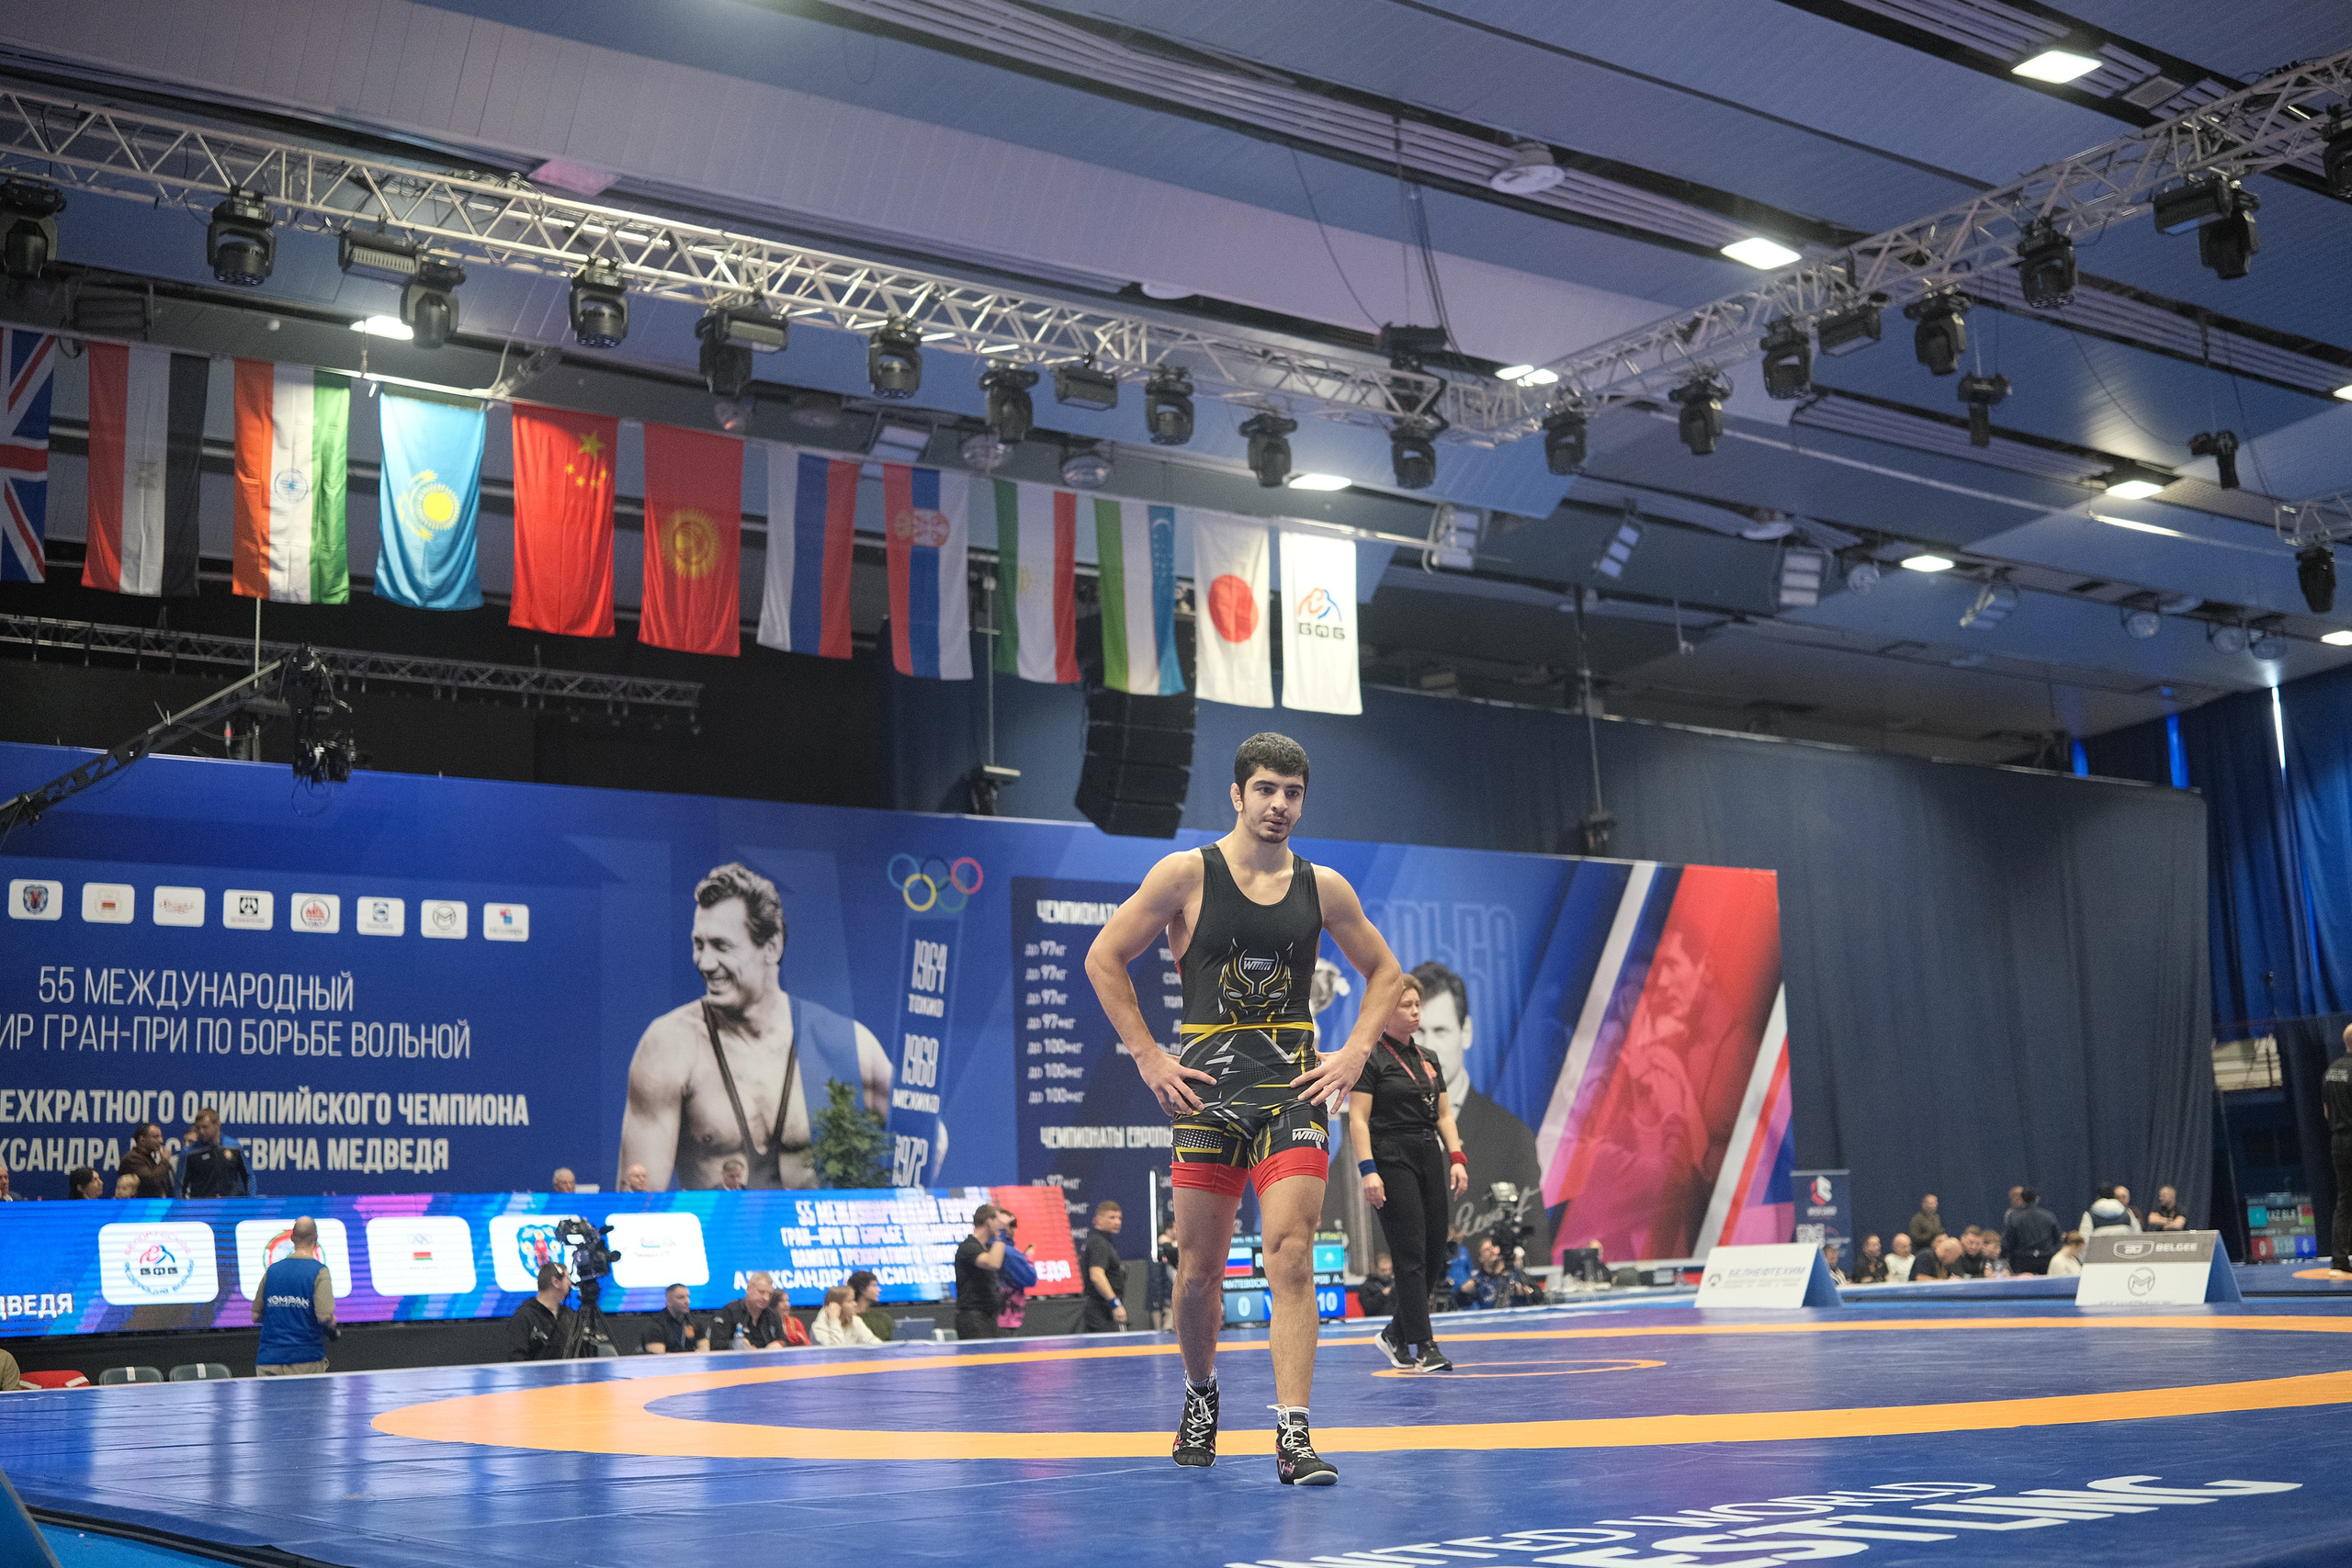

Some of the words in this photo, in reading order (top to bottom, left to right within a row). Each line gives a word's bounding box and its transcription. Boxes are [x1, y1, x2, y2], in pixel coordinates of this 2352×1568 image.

[39, 965, 75, 1004] 55
[85, 967, 354, 1014] МЕЖДУНАРОДНЫЙ
[910, 938, 948, 994] 1964
[43, 1014, 187, 1055] ГРАН-ПРИ
[196, 1017, 232, 1055] ПО
[241, 1018, 343, 1056] БОРЬБЕ
[351, 1019, 470, 1059] ВОЛЬНОЙ
[901, 1032, 940, 1089] 1968
[0, 1089, 175, 1124] ЕХКРАТНОГО
[398, 1092, 530, 1126] ЧЕМПИОНА
[327, 1137, 449, 1175] МЕДВЕДЯ
[1238, 1296, 1251, 1317] 0
[1317, 1292, 1339, 1313] 10
[1488, 1474, 2304, 1568] ESTLING
[1594, 1482, 1996, 1529] WORLD
